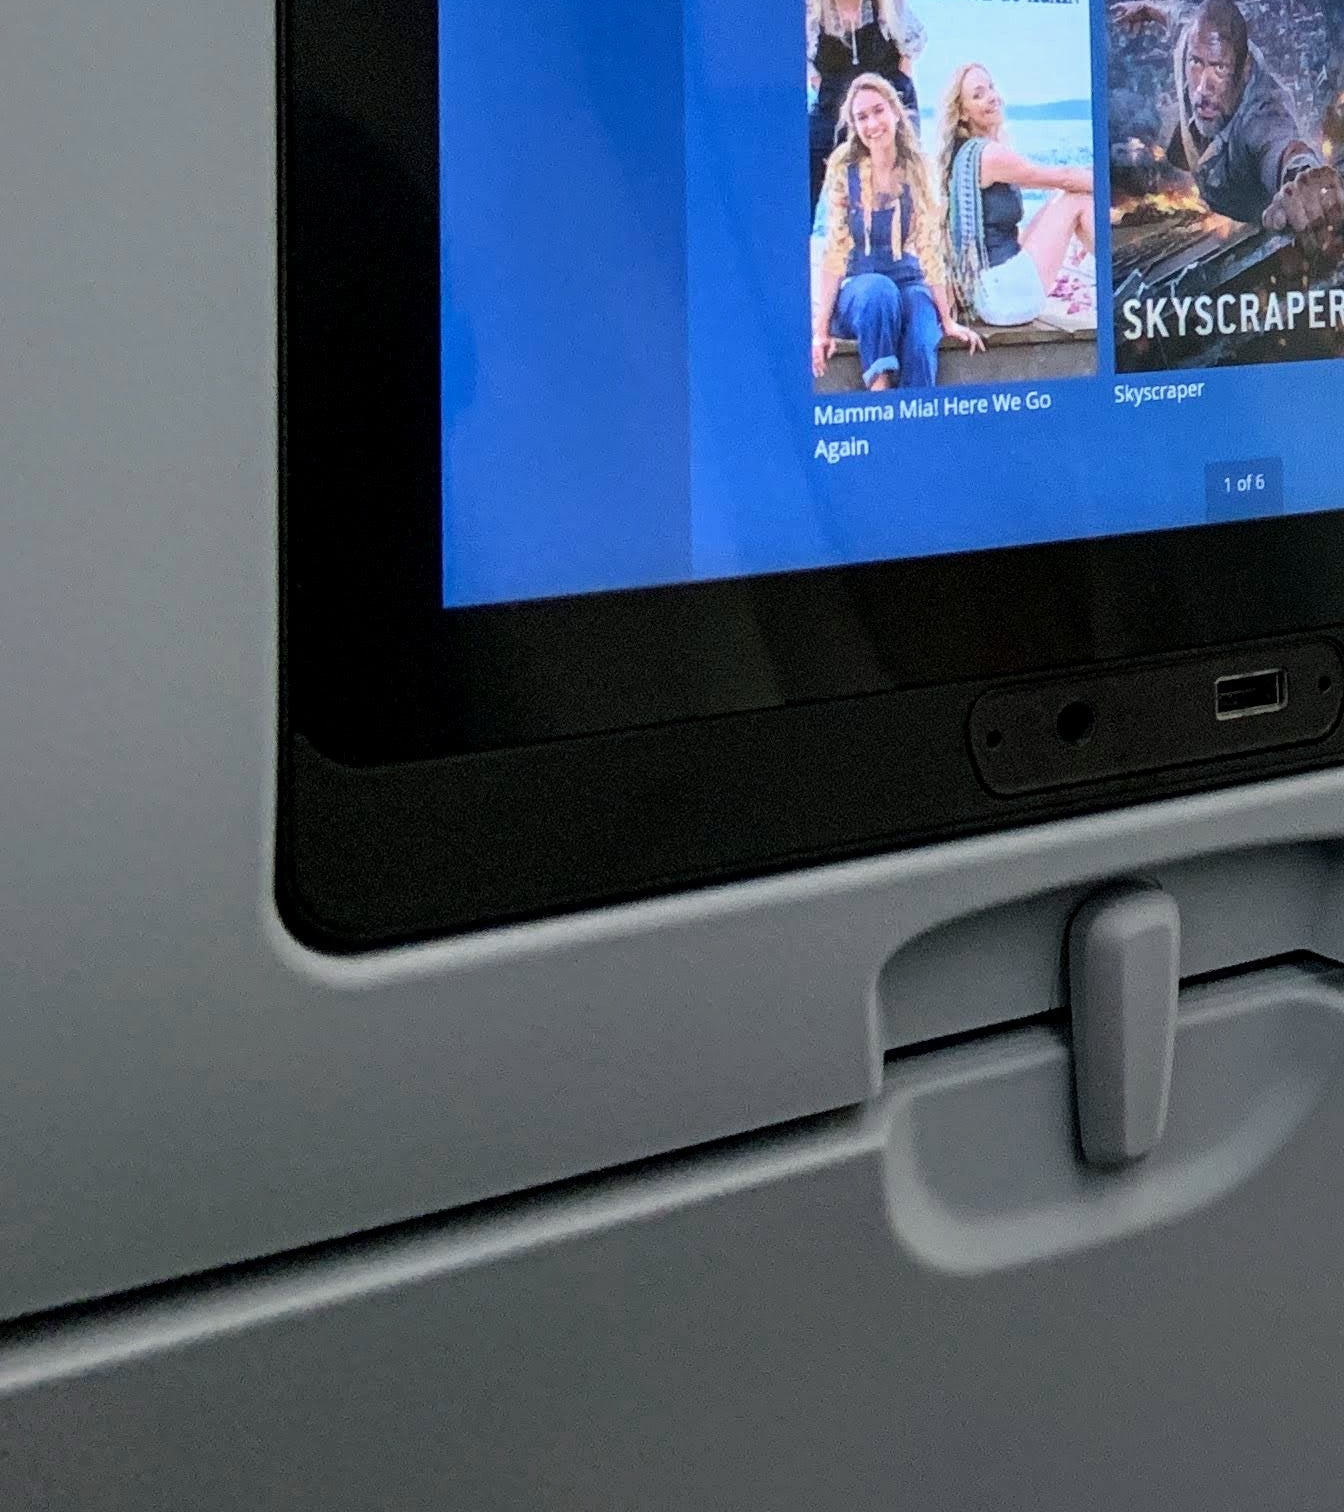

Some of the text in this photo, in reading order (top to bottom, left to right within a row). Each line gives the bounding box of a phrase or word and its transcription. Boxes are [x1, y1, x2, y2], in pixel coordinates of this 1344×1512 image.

[1114, 382, 1205, 407] Skyscraper
[814, 395, 894, 426] Mamma
[943, 396, 988, 417] Here
[991, 392, 1021, 413] We
[1025, 390, 1052, 410] Go
[814, 436, 869, 464] Again
[1224, 473, 1265, 493] 1 of 6
